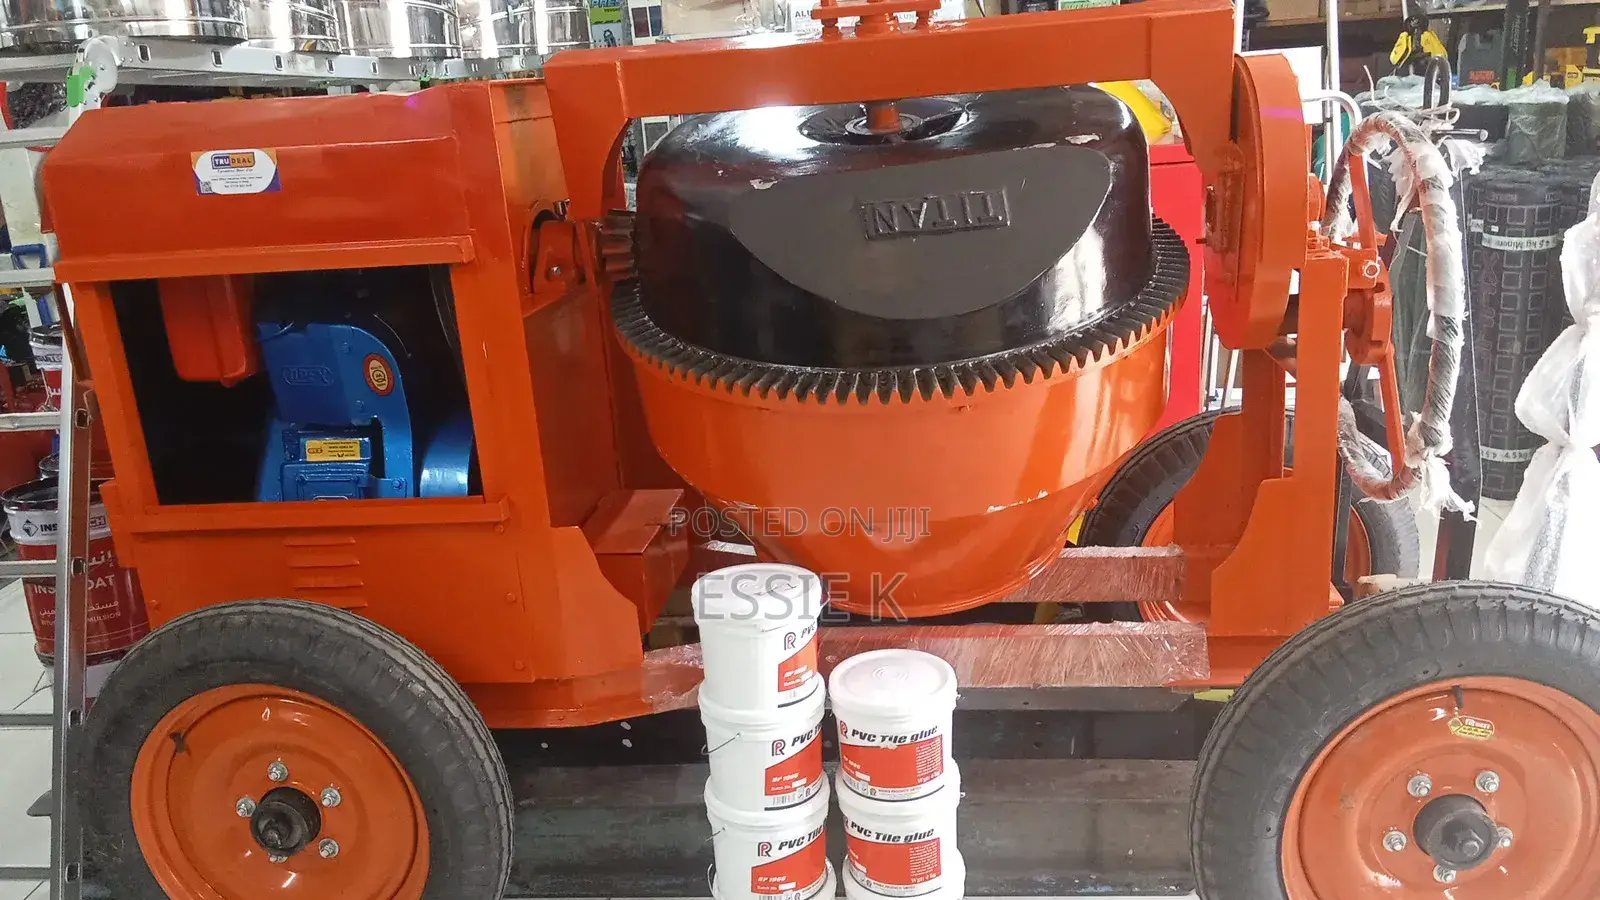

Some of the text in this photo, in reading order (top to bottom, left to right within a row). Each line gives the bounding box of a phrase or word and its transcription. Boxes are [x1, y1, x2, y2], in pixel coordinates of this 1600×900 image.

[872, 194, 1004, 233] TITAN
[791, 729, 813, 747] PVC
[852, 728, 876, 743] PVC
[910, 725, 938, 742] glue
[851, 821, 935, 843] PVC Tile glue
[778, 836, 805, 850] PVC
